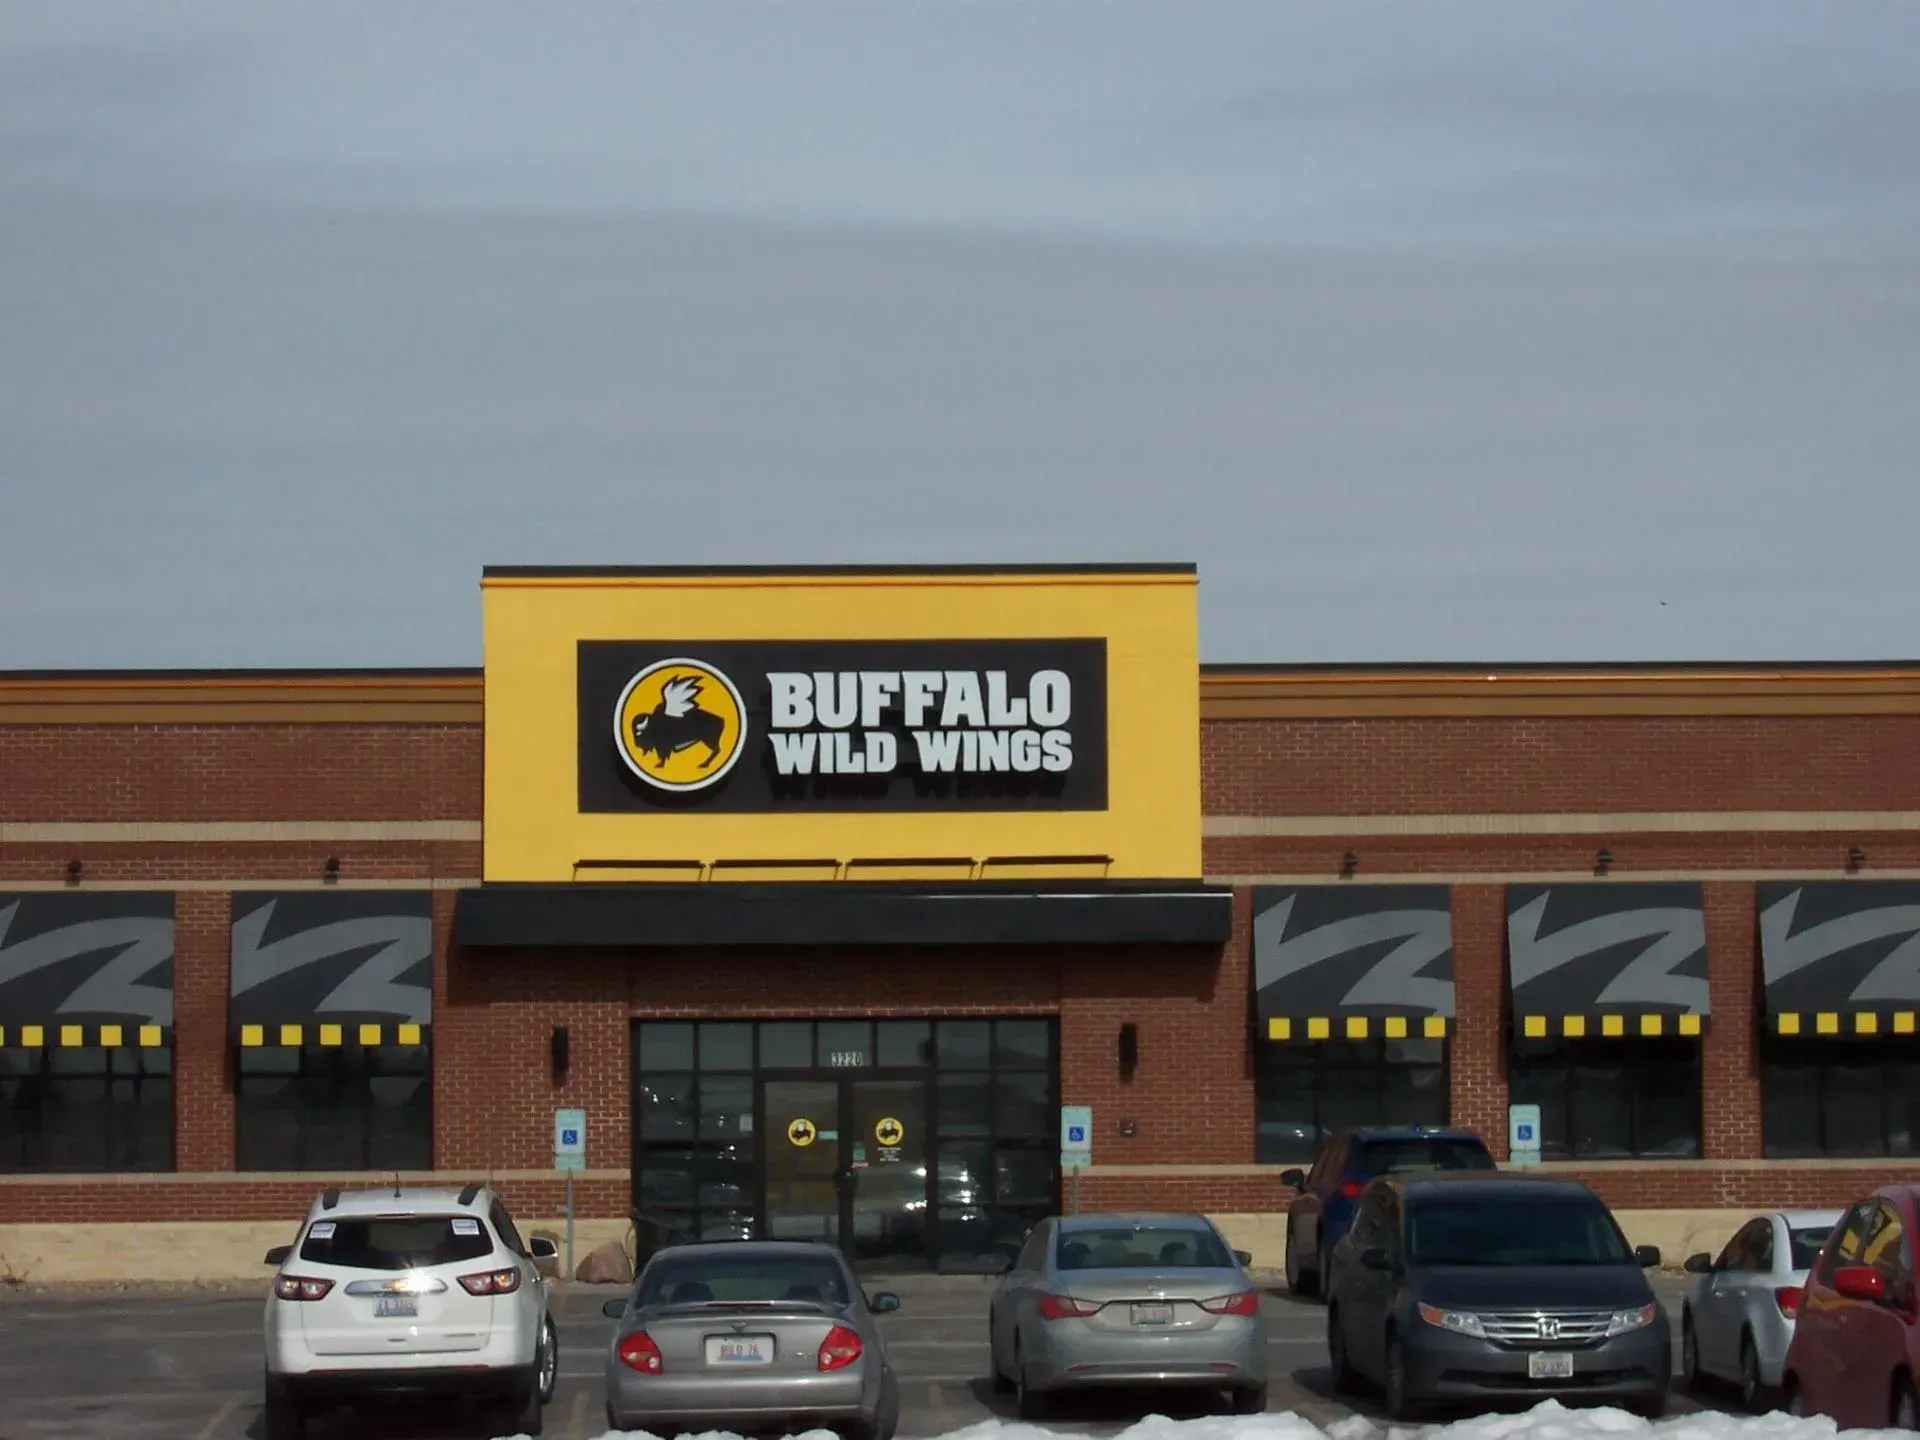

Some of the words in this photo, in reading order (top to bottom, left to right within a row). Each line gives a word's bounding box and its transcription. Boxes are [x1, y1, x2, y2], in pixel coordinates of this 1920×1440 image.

[766, 669, 1071, 728] BUFFALO
[768, 731, 897, 775] WILD
[912, 729, 1073, 772] WINGS
[831, 1051, 863, 1068] 3220
